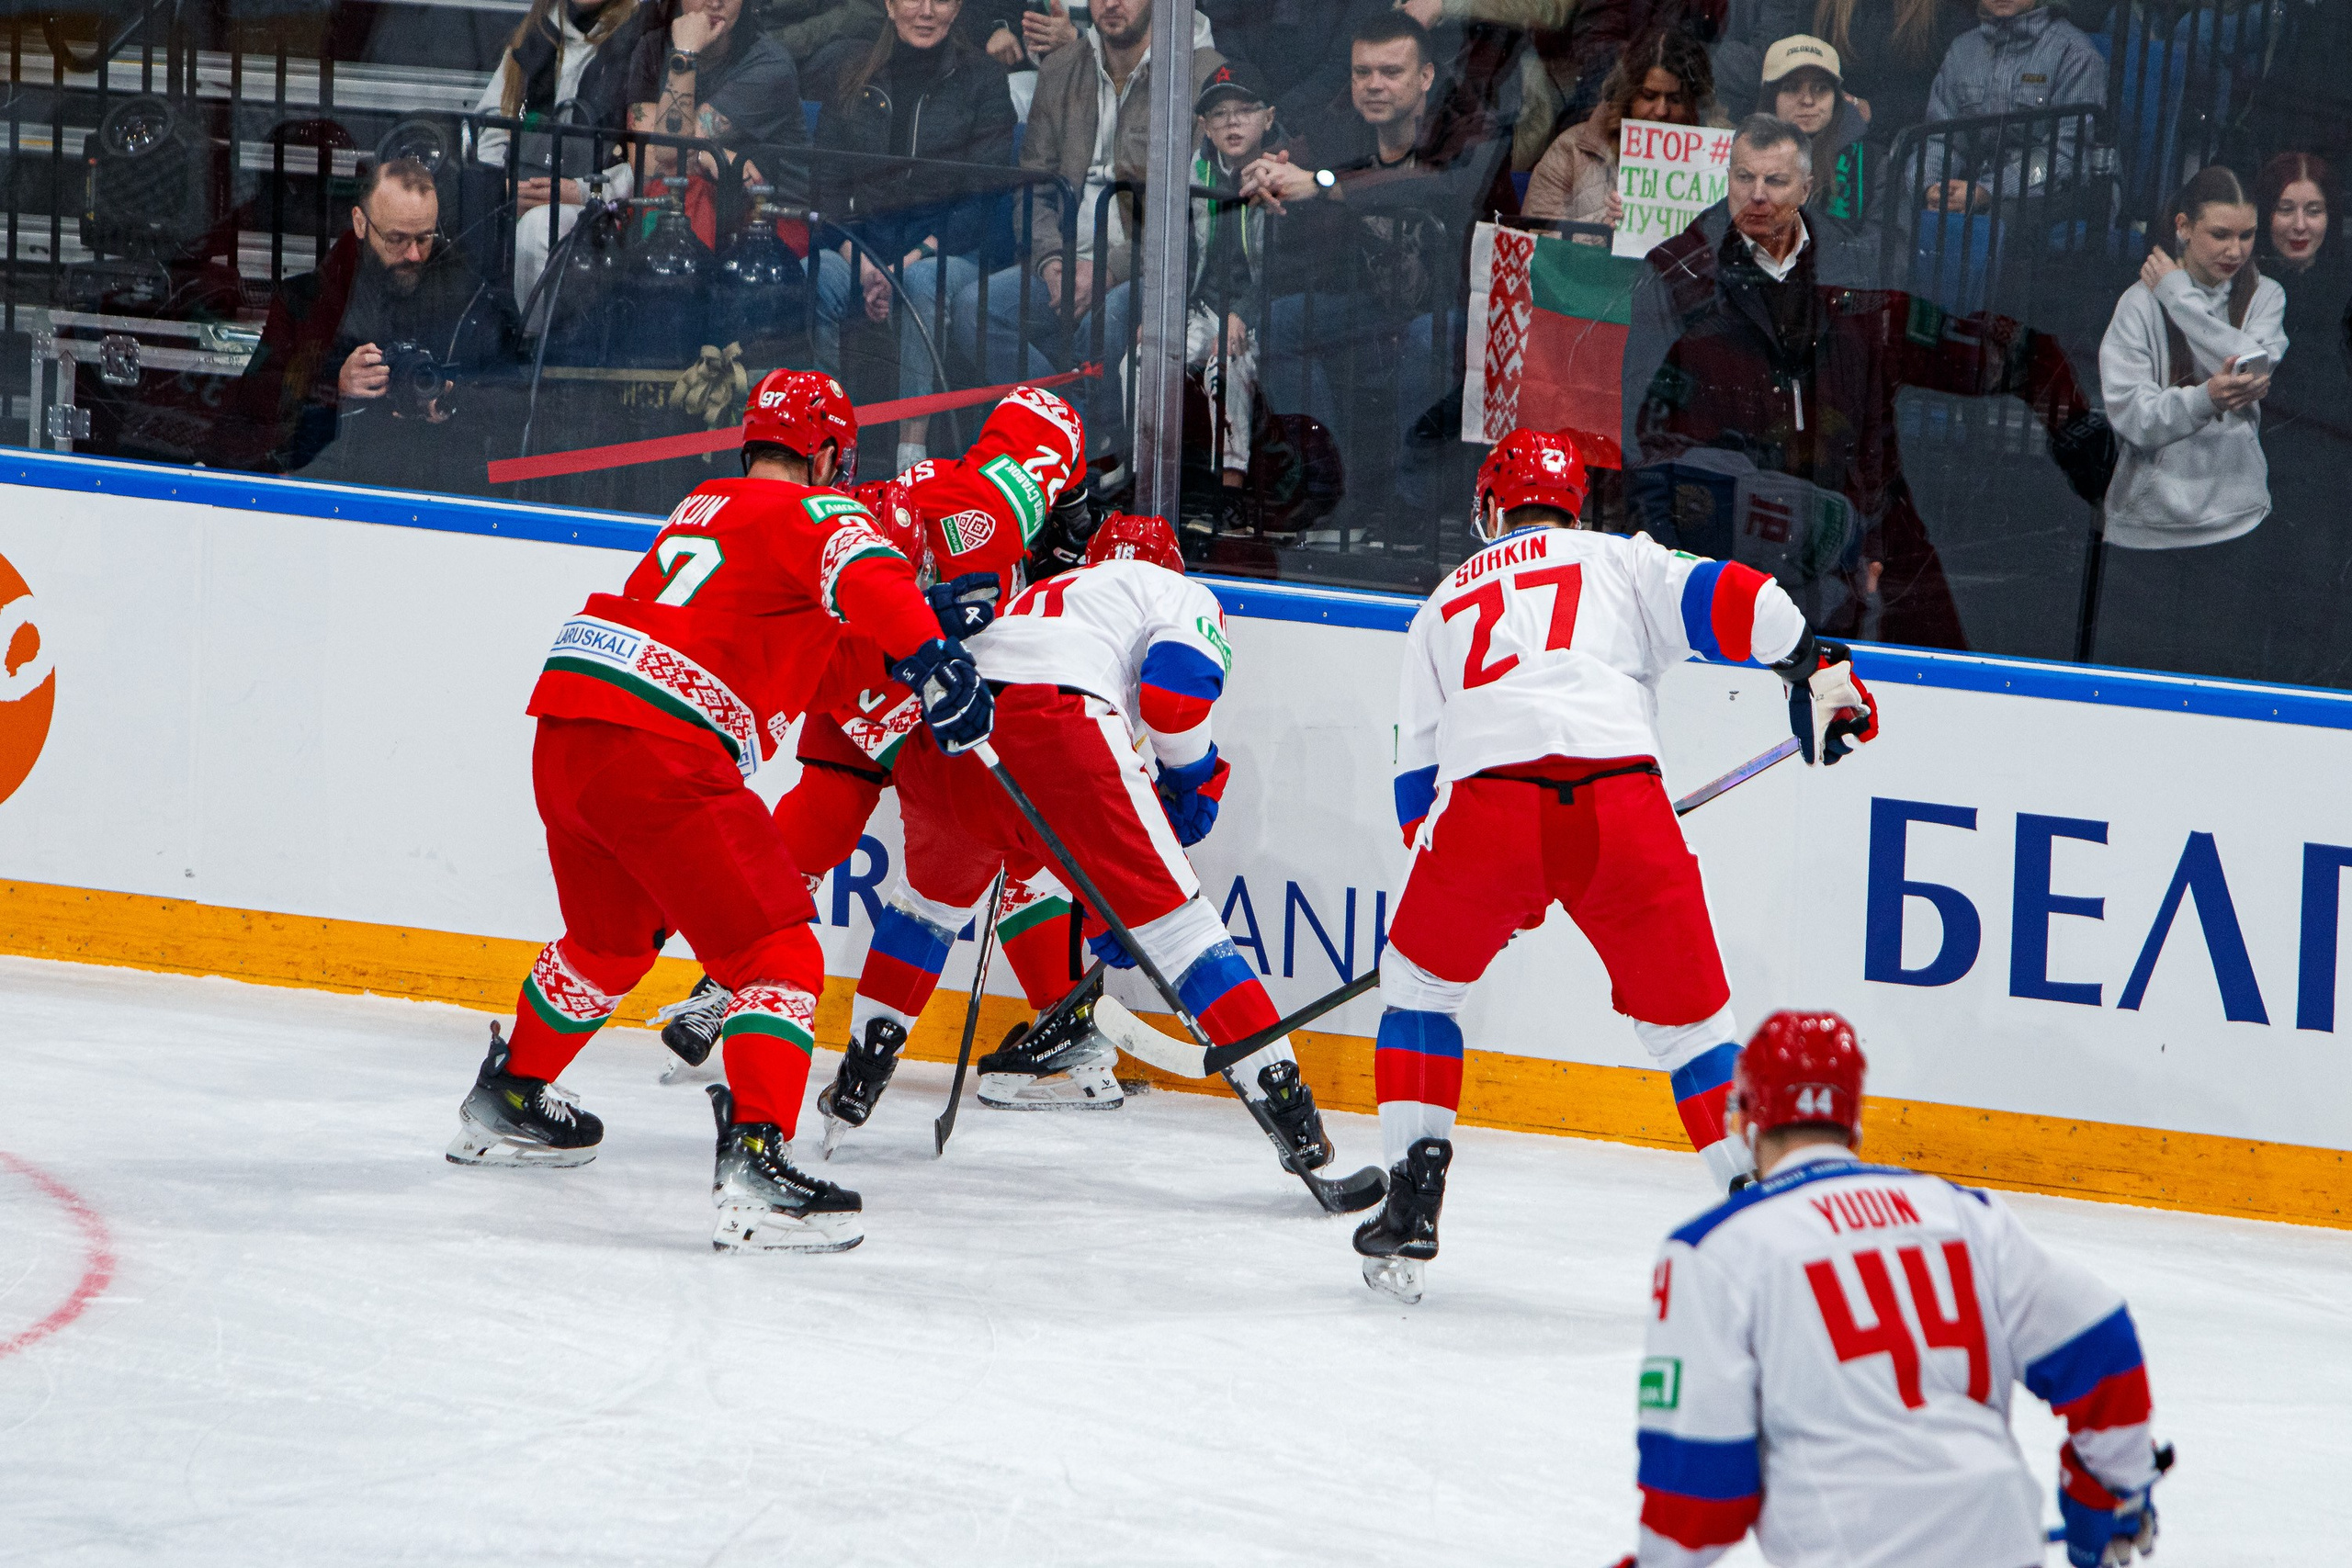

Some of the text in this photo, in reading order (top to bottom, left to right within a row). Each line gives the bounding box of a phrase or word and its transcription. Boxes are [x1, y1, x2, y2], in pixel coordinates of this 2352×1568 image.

[1787, 45, 1823, 57] COLORADO
[1623, 125, 1702, 163] ЕГОР
[1620, 165, 1659, 198] ТЫ
[760, 391, 786, 407] 97
[828, 414, 846, 426] CCM
[1542, 447, 1566, 472] 27
[1455, 535, 1547, 588] SORKIN
[1441, 562, 1582, 690] 27
[1036, 1039, 1071, 1063] BAUER
[1796, 1088, 1832, 1115] 44
[1810, 1189, 1921, 1235] YUDIN
[1804, 1238, 1991, 1409] 44
